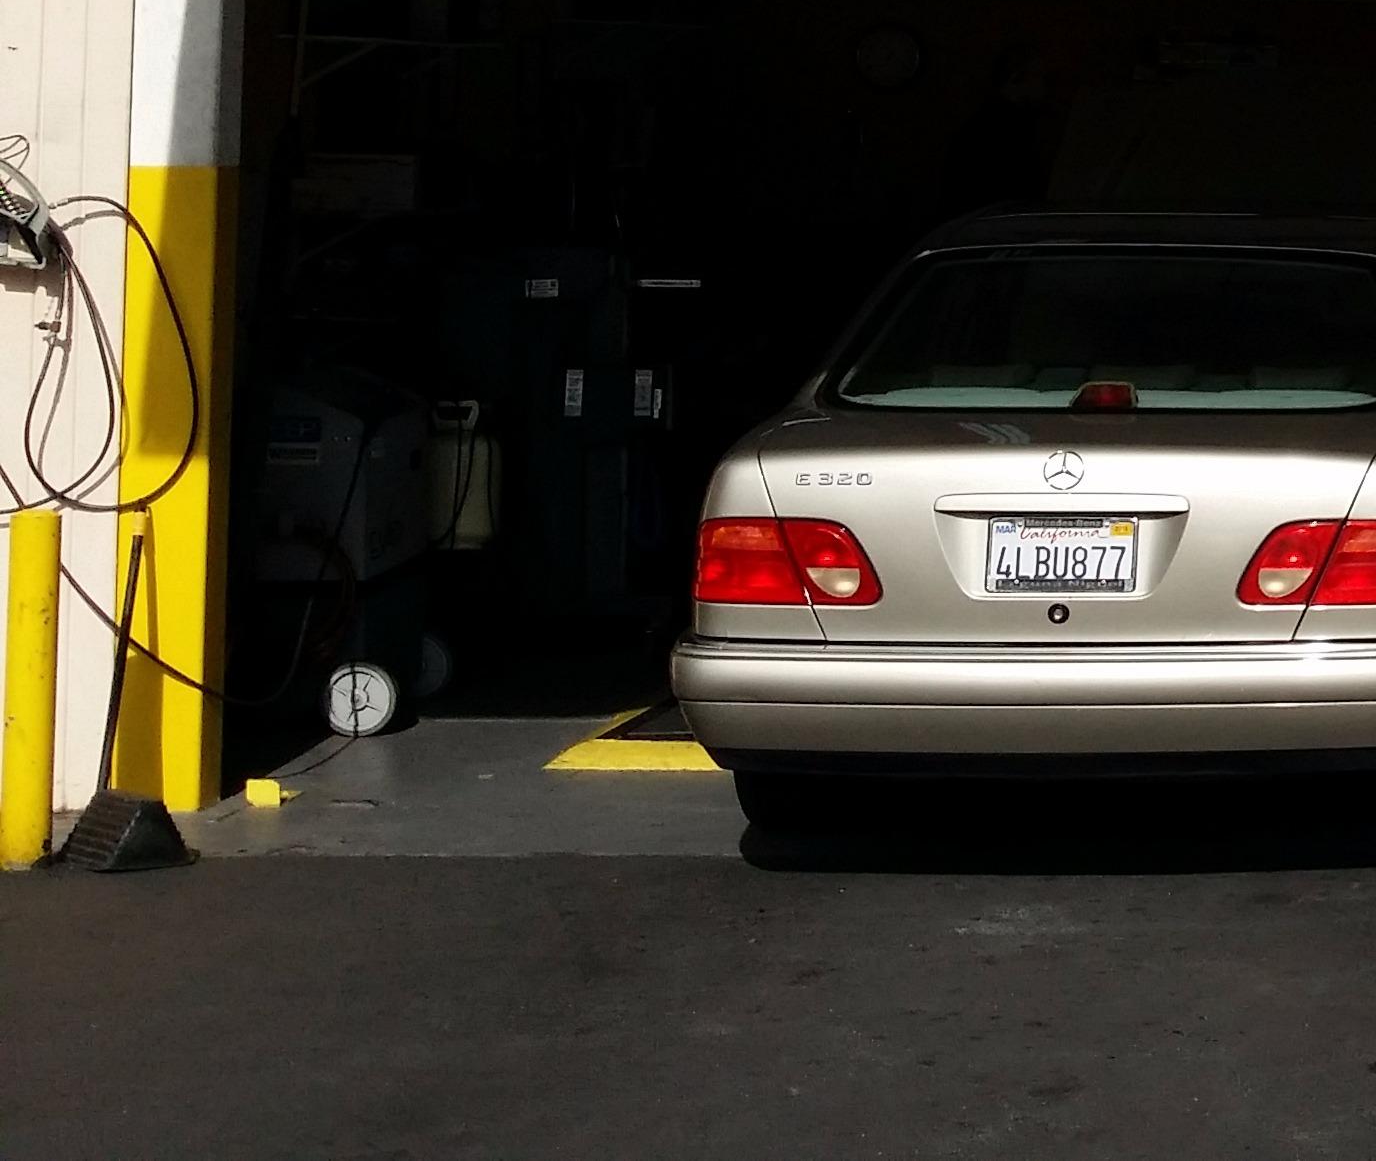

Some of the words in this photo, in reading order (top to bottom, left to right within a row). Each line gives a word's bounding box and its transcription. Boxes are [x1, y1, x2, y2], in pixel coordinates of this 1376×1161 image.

[796, 473, 811, 486] E
[818, 473, 872, 486] 320
[995, 525, 1017, 534] MAR
[1020, 528, 1104, 544] California
[996, 546, 1126, 580] 4LBU877
